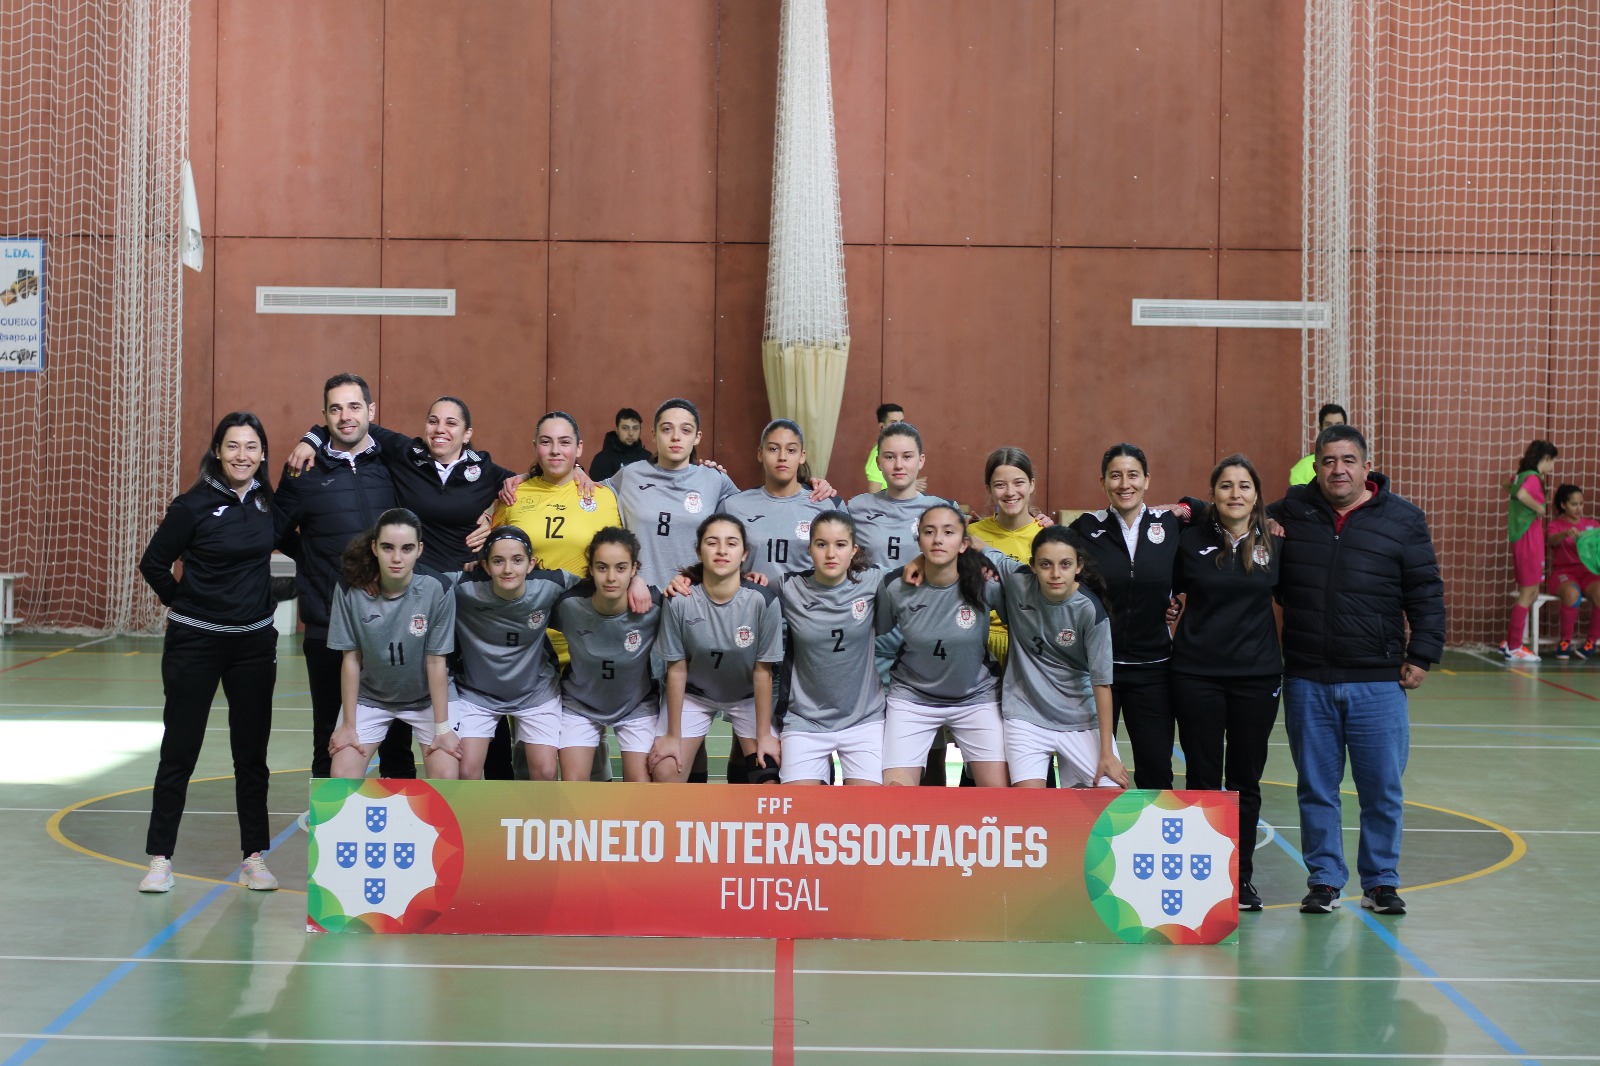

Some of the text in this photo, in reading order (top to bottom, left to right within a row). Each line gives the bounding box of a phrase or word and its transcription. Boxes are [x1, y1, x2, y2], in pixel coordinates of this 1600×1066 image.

[5, 248, 34, 258] LDA.
[545, 516, 565, 539] 12
[657, 512, 671, 536] 8
[767, 539, 788, 563] 10
[887, 536, 900, 560] 6
[506, 632, 519, 647] 9
[831, 629, 845, 652] 2
[933, 639, 946, 660] 4
[1031, 636, 1043, 656] 3
[389, 641, 404, 666] 11
[710, 651, 723, 669] 7
[602, 660, 614, 679] 5
[757, 797, 793, 814] FPF
[500, 816, 1048, 877] TORNEIO INTERASSOCIAÇÕES
[721, 877, 829, 912] FUTSAL
